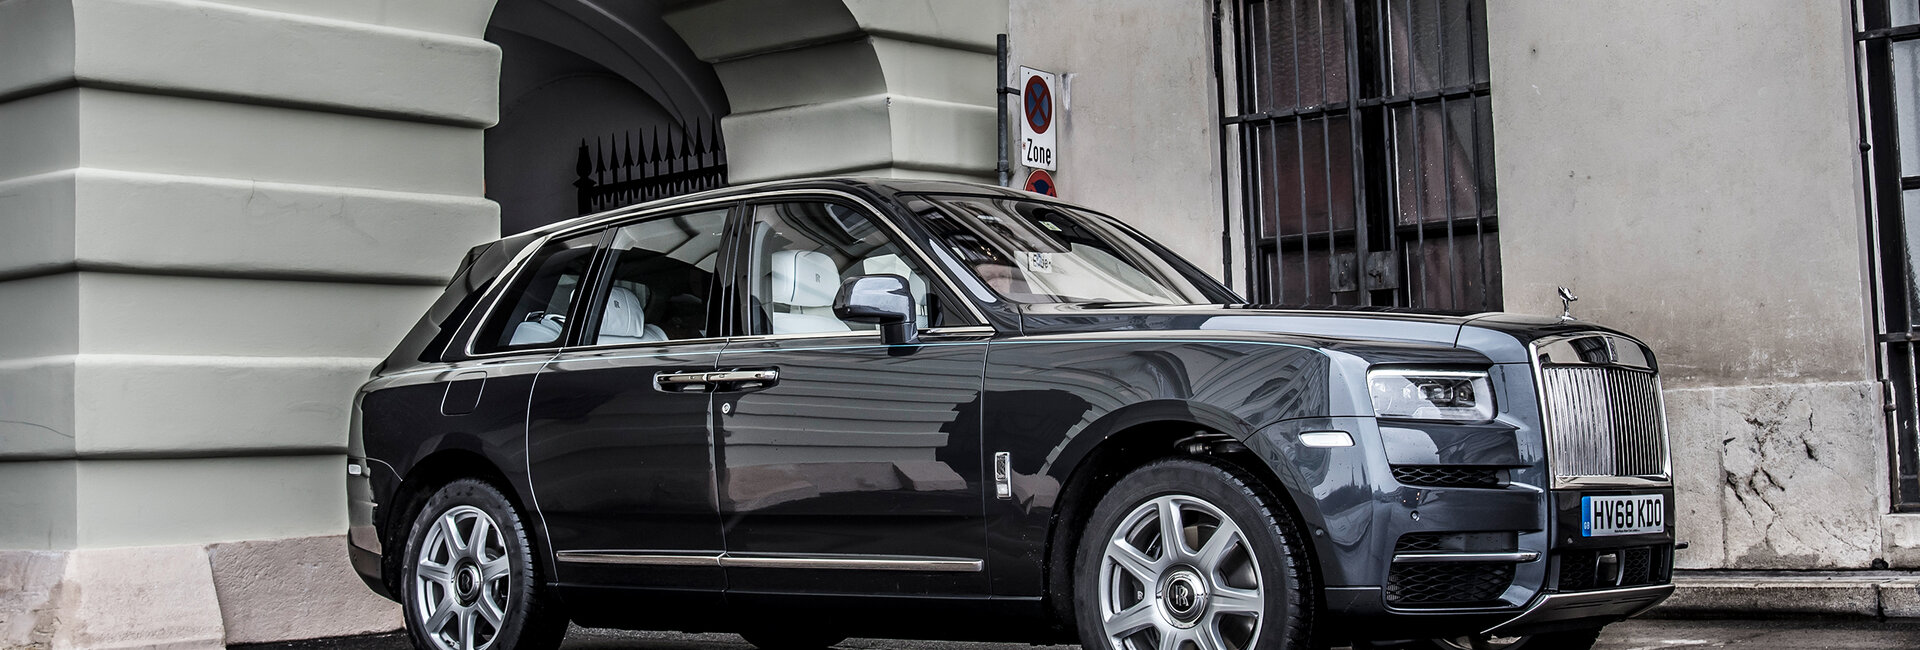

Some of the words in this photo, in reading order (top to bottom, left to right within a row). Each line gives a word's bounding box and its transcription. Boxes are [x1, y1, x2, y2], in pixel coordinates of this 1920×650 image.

[1027, 138, 1051, 166] Zone
[1594, 500, 1633, 529] HV68
[1638, 499, 1661, 527] KDO
